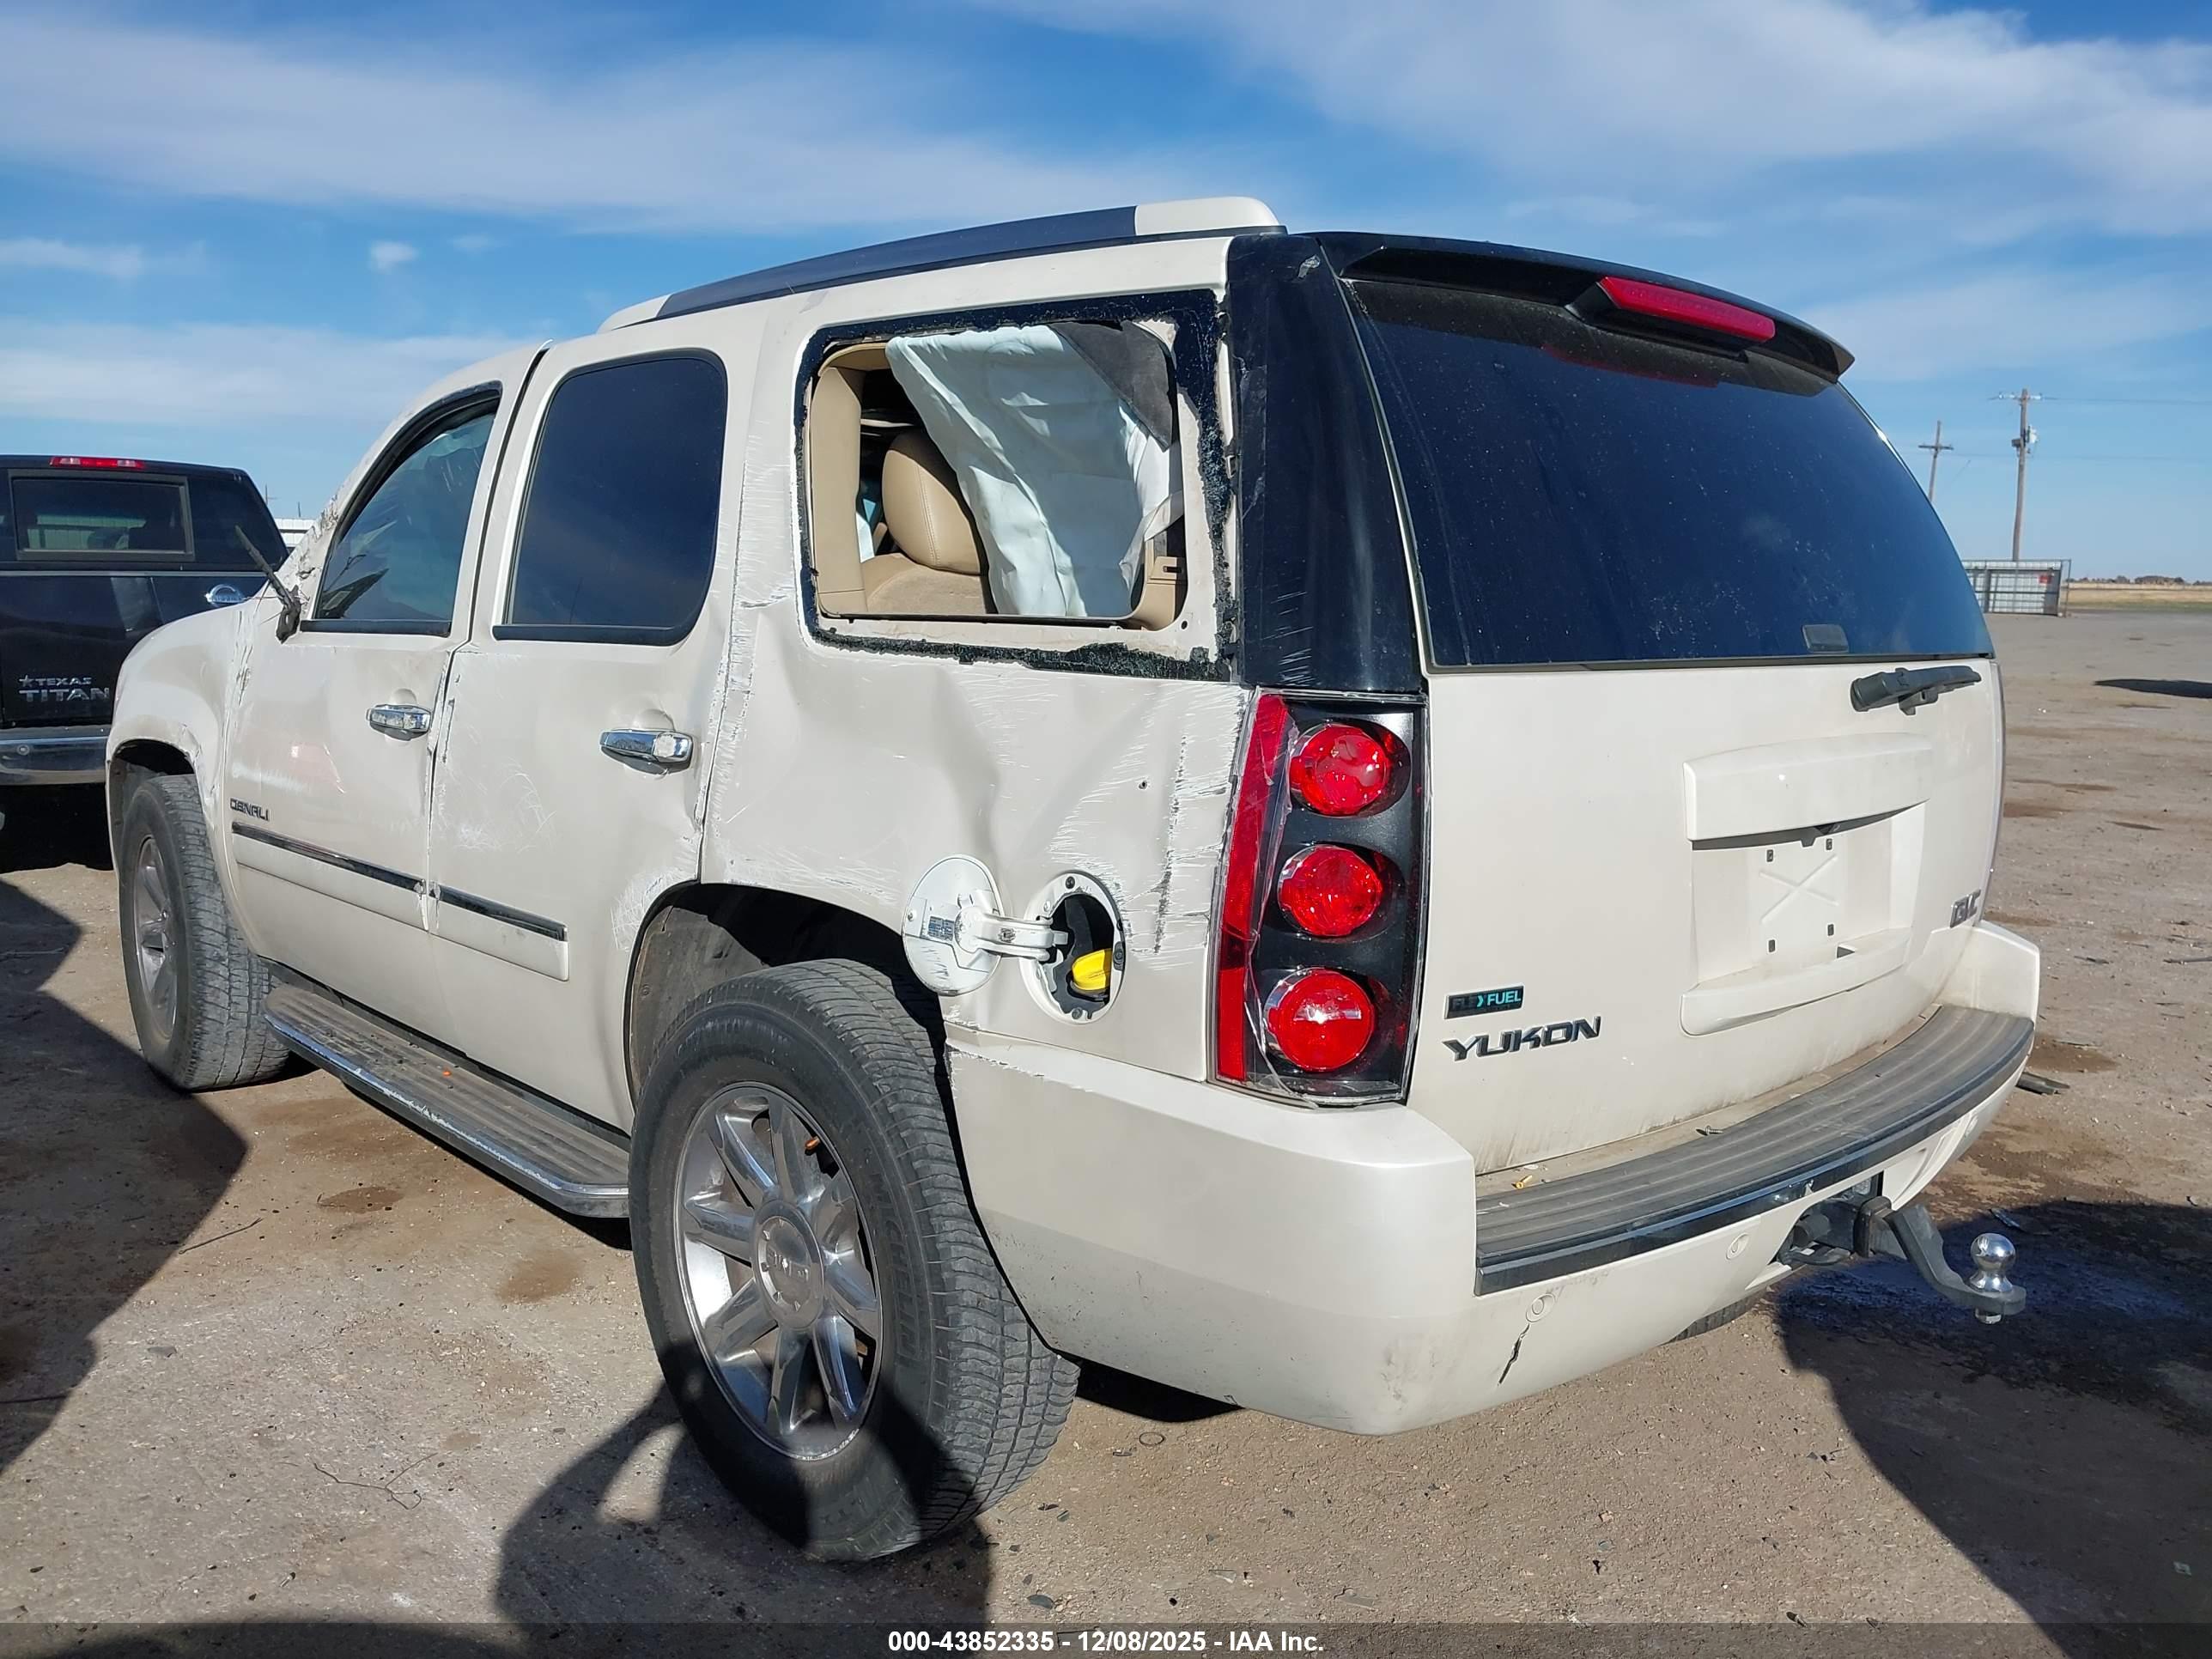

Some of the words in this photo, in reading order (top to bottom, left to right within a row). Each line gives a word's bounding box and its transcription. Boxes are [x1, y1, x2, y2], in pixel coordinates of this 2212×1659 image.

[35, 677, 92, 686] TEXAS
[19, 687, 110, 702] TITAN
[229, 797, 270, 822] DENALI
[1486, 989, 1522, 1006] FUEL
[1442, 1016, 1601, 1061] YUKON
